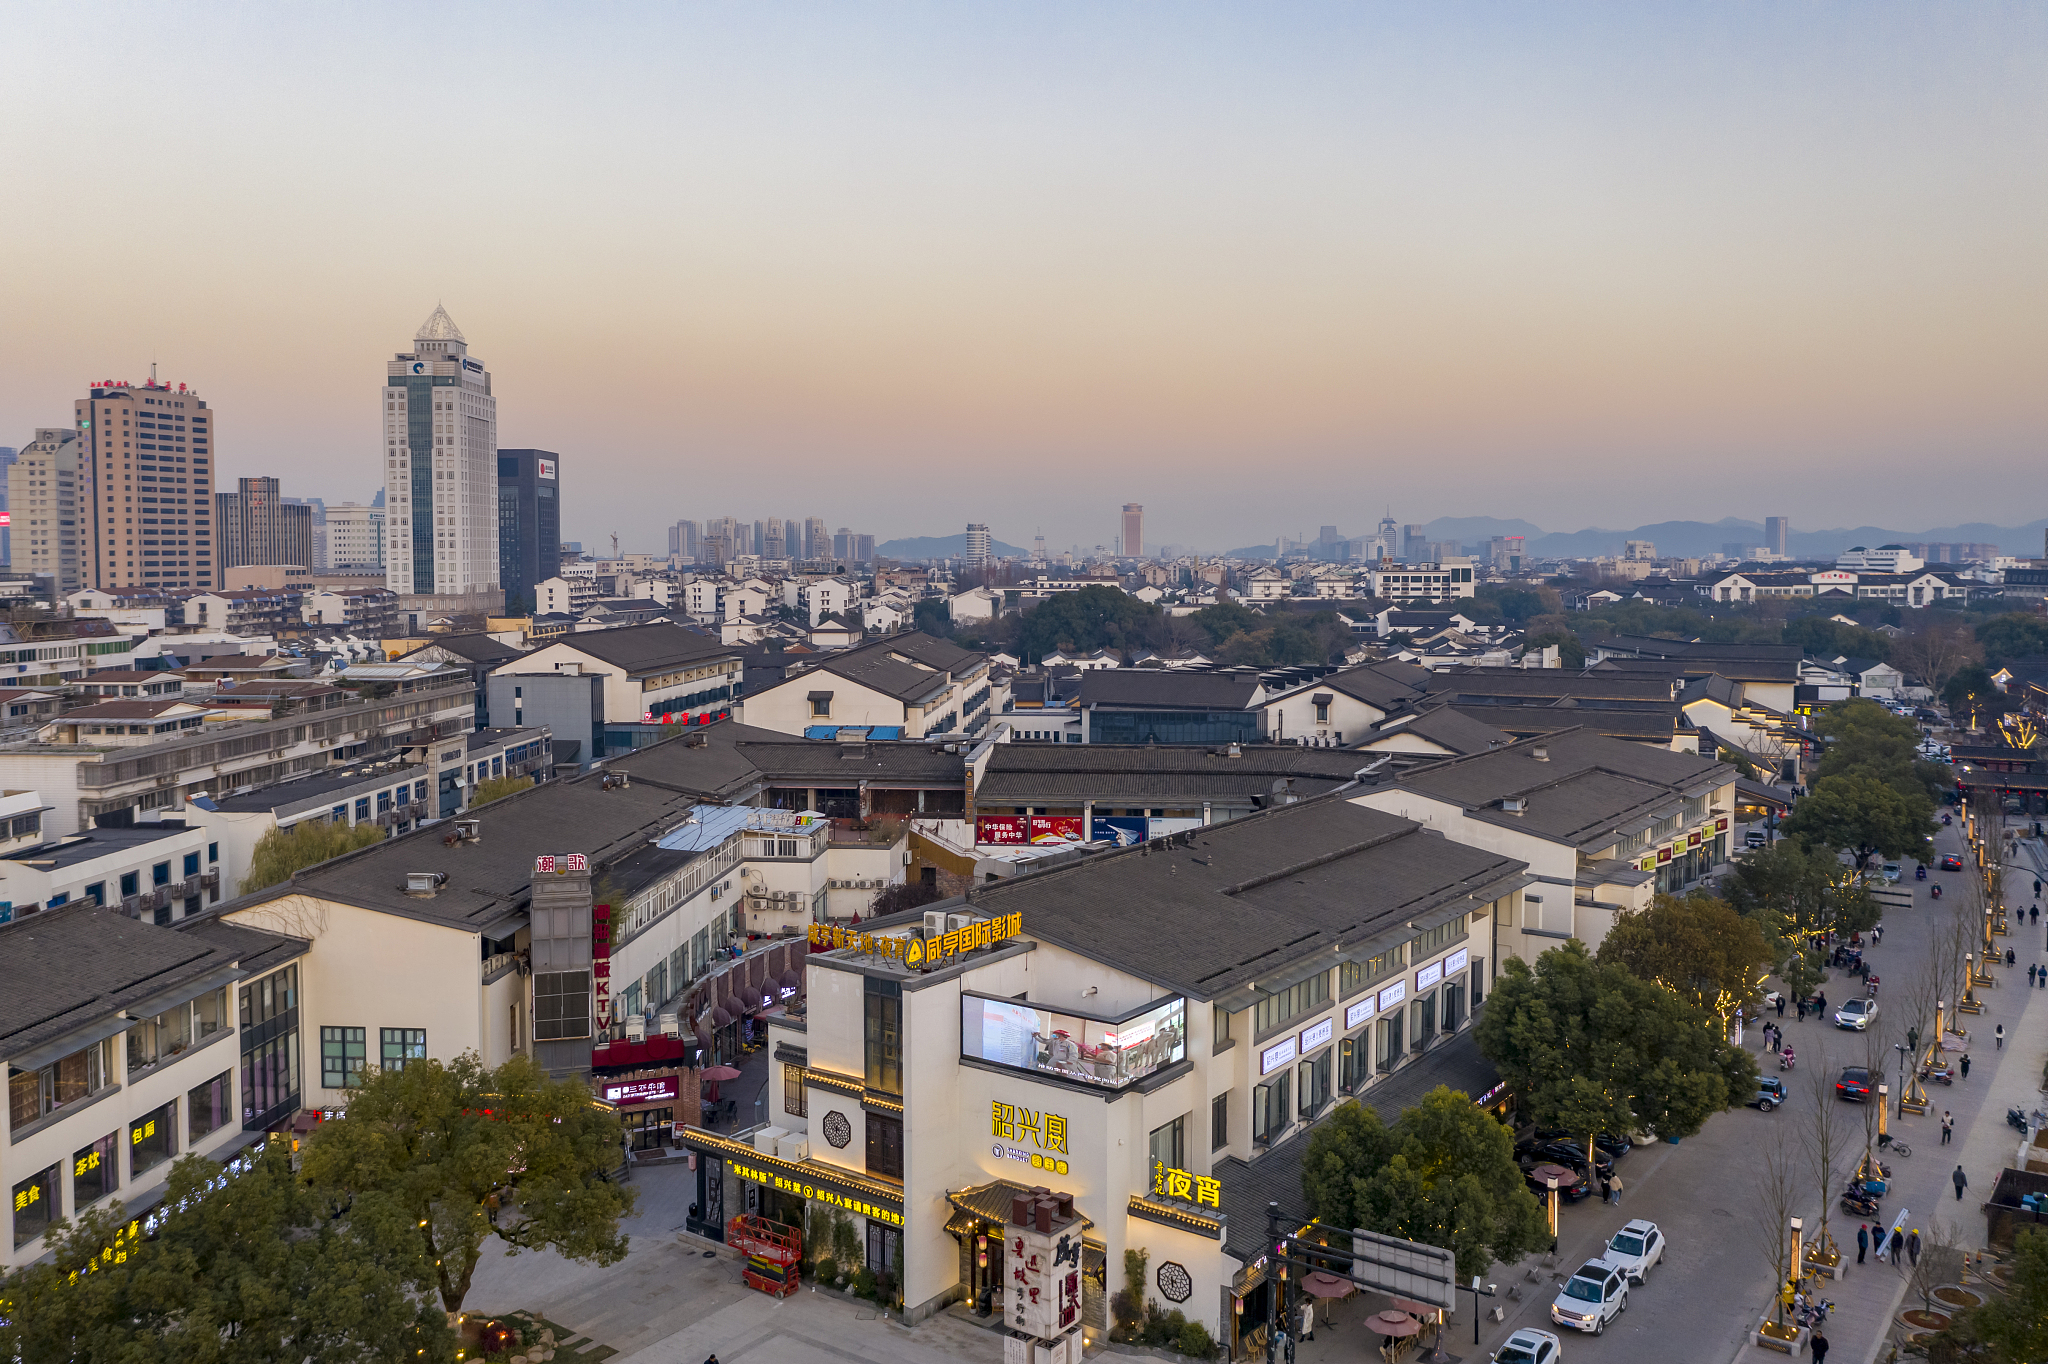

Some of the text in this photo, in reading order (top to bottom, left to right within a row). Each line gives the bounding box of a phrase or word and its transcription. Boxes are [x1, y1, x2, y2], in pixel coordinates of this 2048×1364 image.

[795, 815, 813, 826] BAR
[985, 823, 1013, 831] 中华保险
[994, 831, 1023, 839] 服务中华
[537, 854, 585, 872] 潮歌
[925, 911, 1023, 964] 咸亨国际影城
[132, 1120, 155, 1145] 包厢
[74, 1151, 100, 1177] 茶饮
[15, 1185, 41, 1212] 美食
[1167, 1167, 1222, 1208] 夜宵
